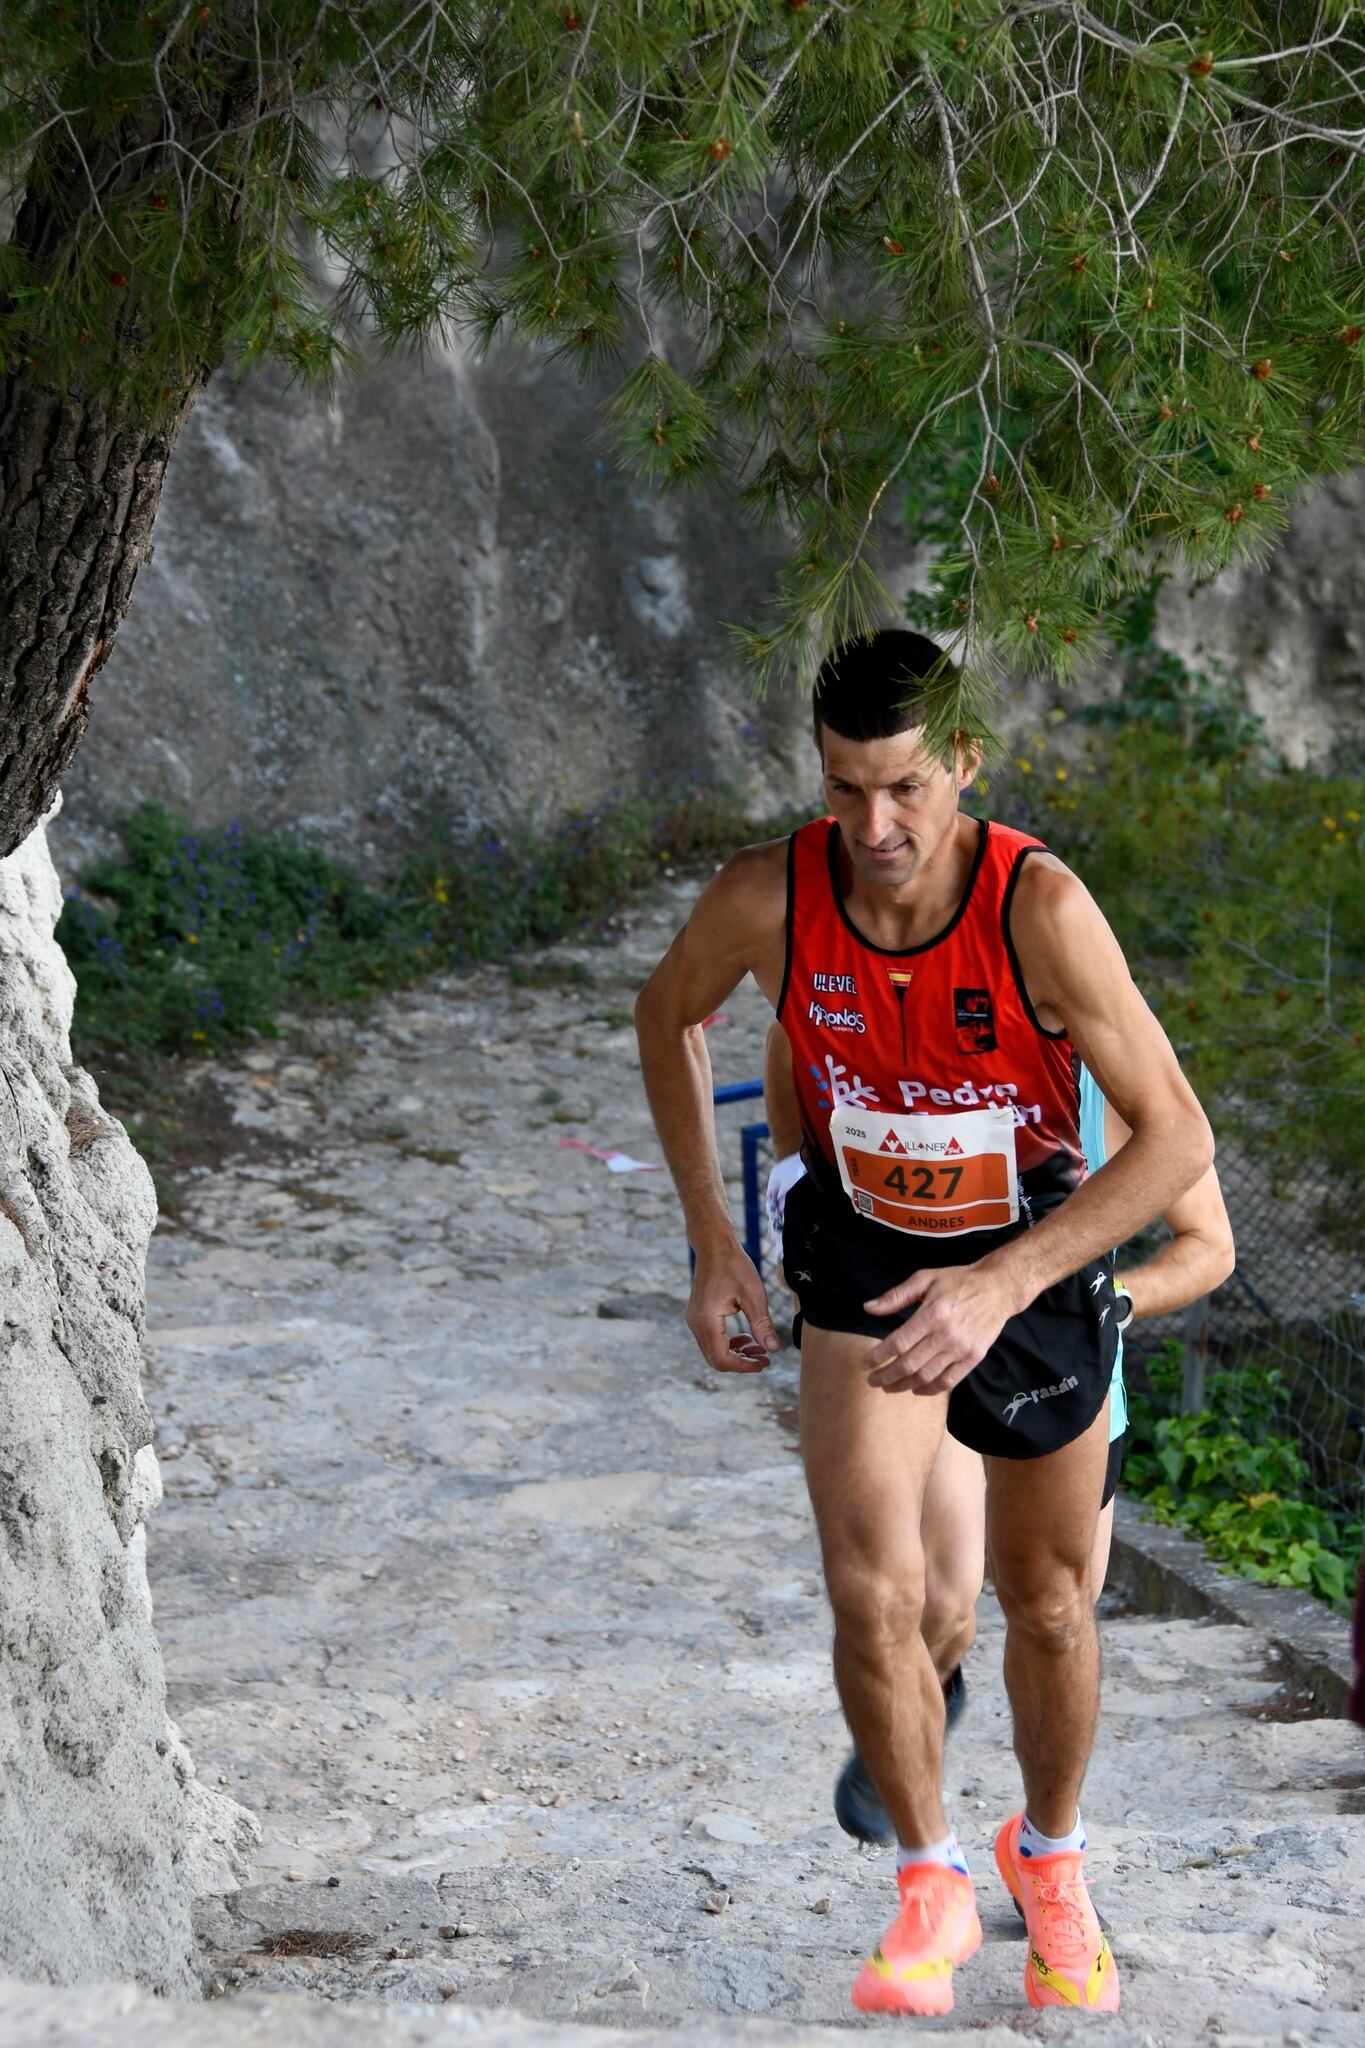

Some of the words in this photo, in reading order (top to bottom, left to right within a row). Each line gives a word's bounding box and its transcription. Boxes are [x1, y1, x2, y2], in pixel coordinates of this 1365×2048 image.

[845, 1126, 867, 1139] 2025
[883, 1165, 964, 1200] 427
[907, 1216, 966, 1229] ANDRES
